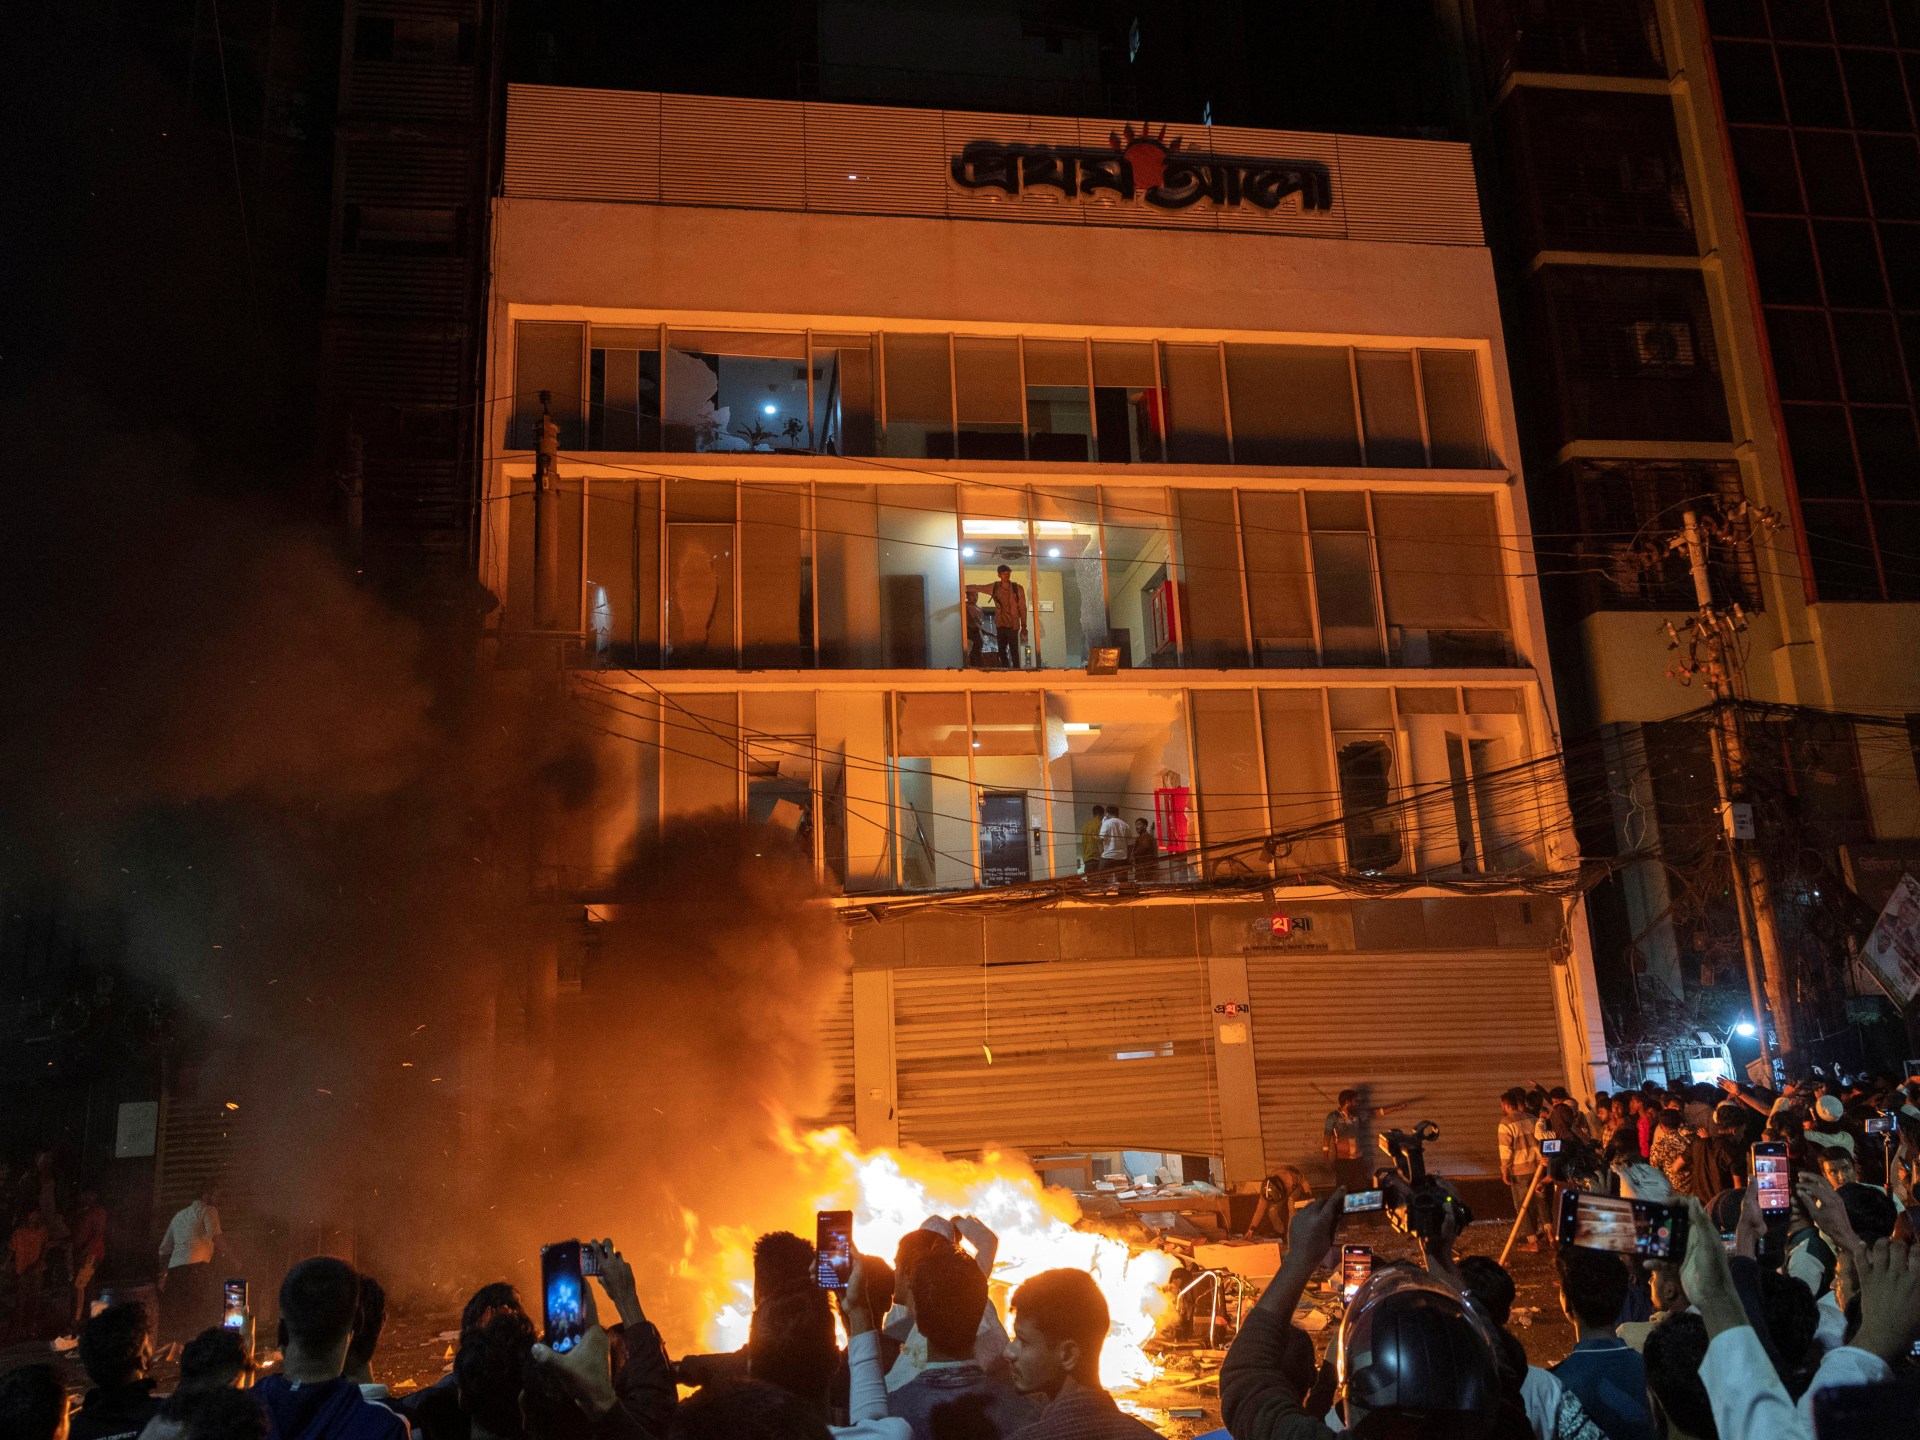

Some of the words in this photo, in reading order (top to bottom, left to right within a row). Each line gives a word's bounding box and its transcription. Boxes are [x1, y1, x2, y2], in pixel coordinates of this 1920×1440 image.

[949, 140, 1135, 199] প্রথম
[1145, 152, 1331, 213] আলো
[1214, 1004, 1249, 1014] প্রথমা
